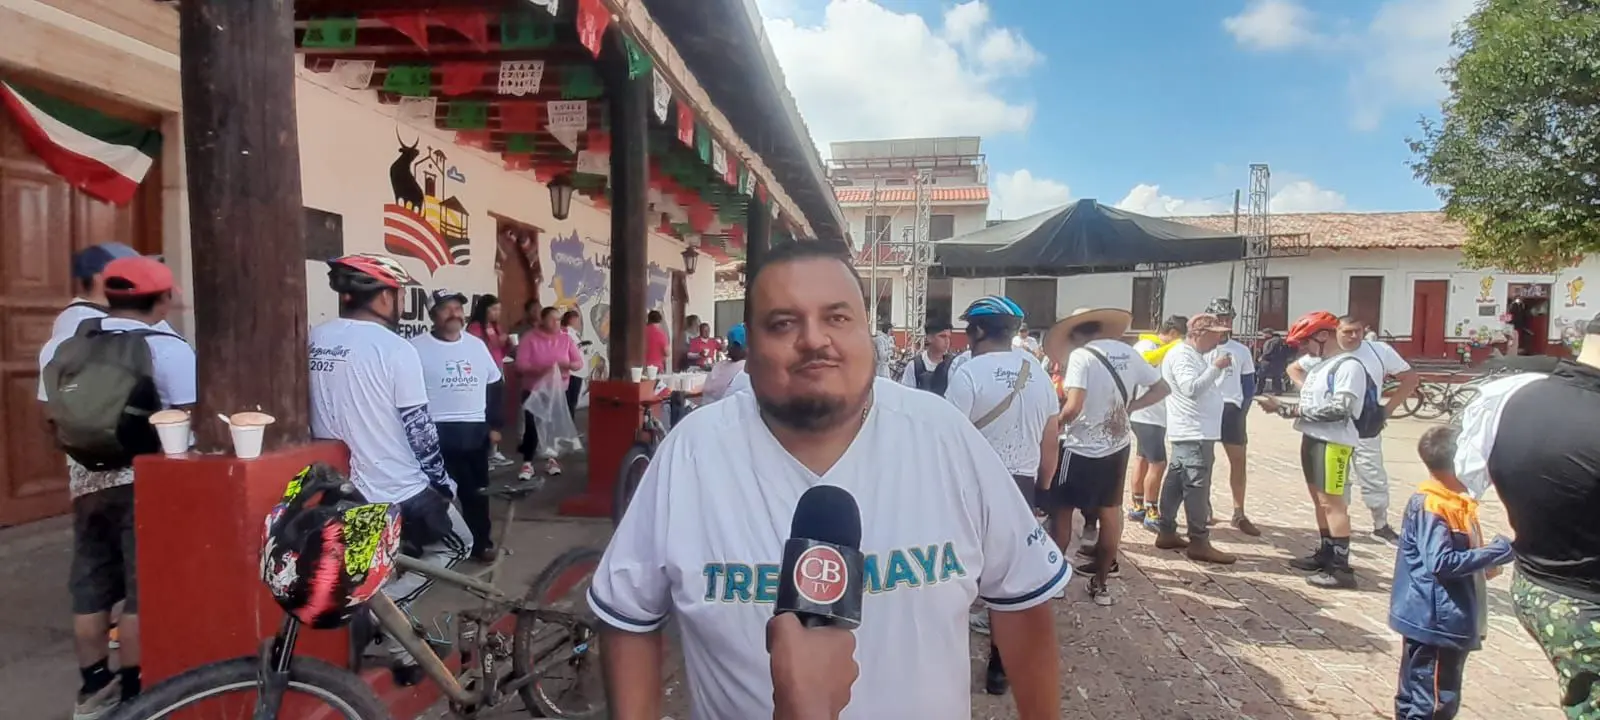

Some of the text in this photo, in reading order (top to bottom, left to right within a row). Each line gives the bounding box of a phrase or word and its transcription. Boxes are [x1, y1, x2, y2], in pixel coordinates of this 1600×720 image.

[310, 360, 335, 373] 2025
[801, 557, 841, 583] CB
[703, 562, 780, 603] TRE
[811, 581, 830, 594] TV
